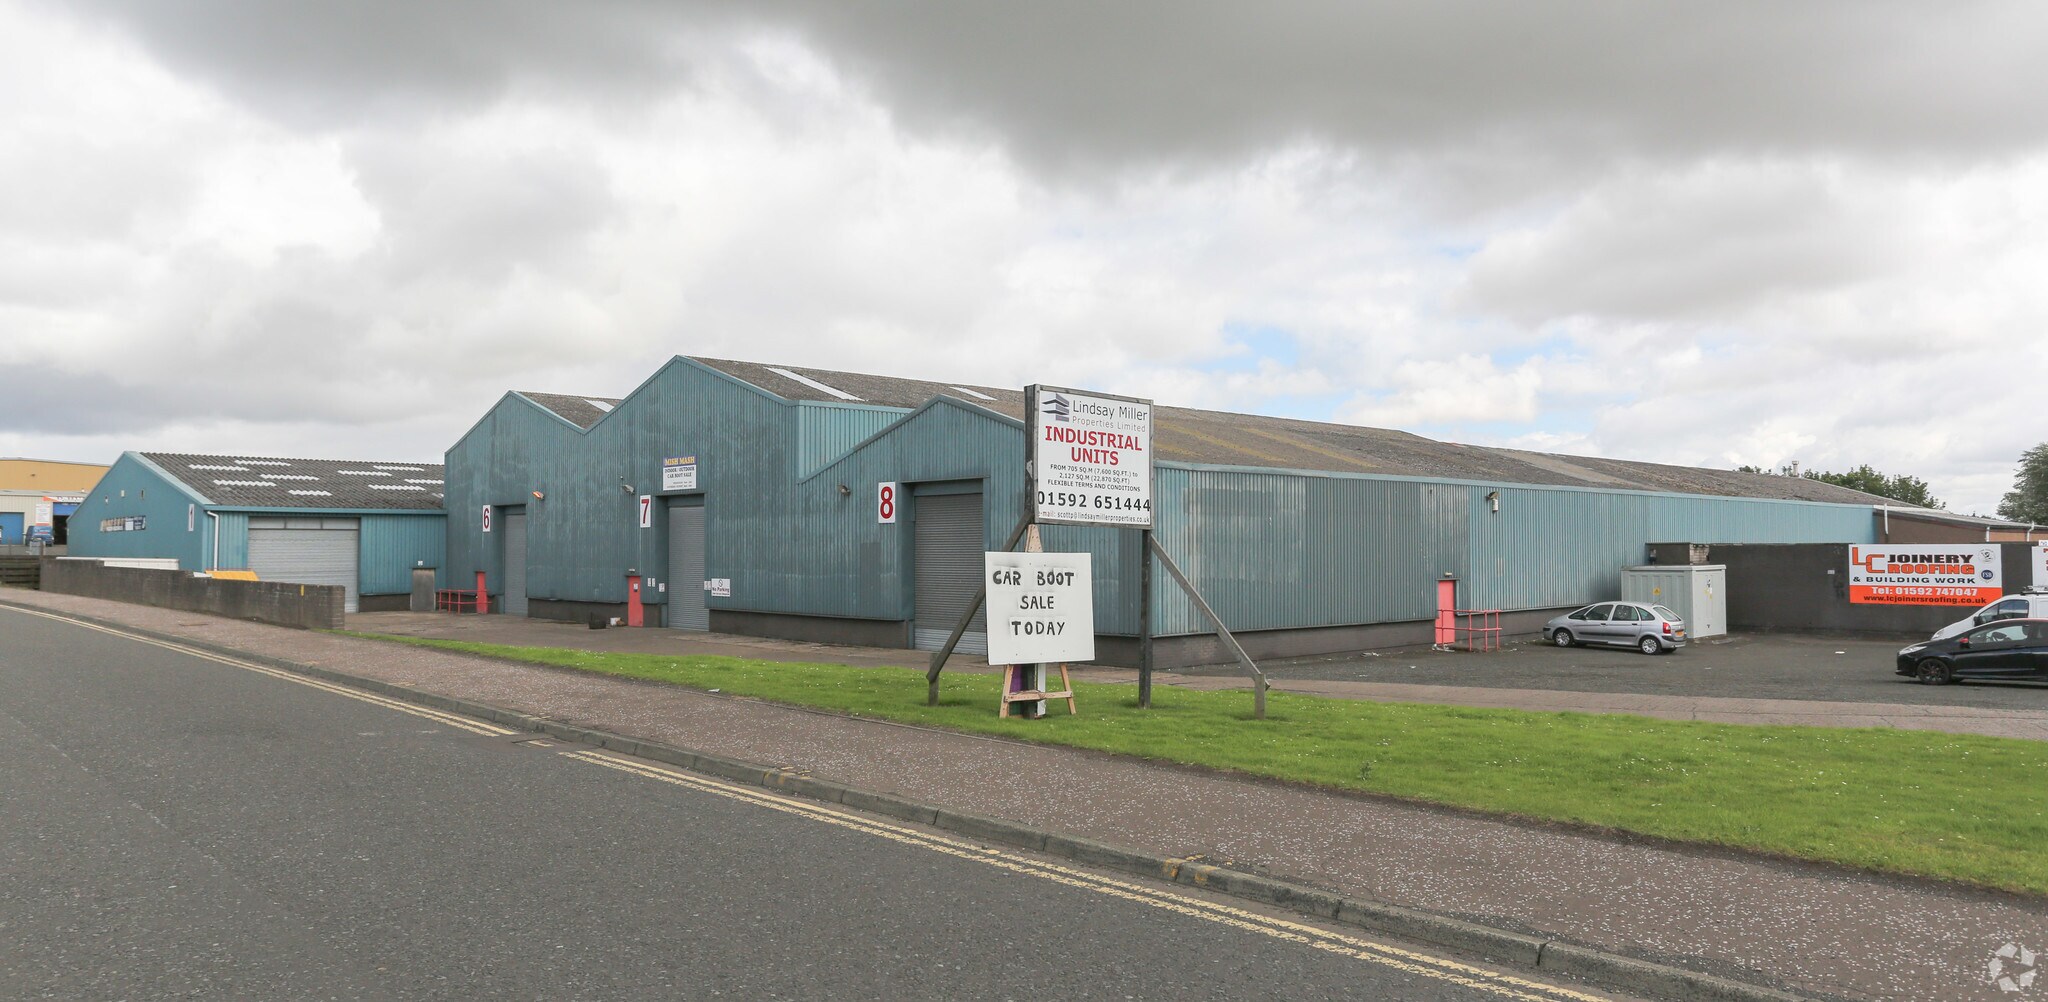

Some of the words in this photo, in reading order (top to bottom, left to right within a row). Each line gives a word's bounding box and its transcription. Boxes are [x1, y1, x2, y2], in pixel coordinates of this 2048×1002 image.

[1073, 400, 1115, 419] Lindsay
[1119, 406, 1148, 420] Miller
[1072, 416, 1114, 429] Properties
[1117, 421, 1146, 432] Limited
[1045, 425, 1142, 451] INDUSTRIAL
[1071, 447, 1119, 466] UNITS
[1047, 479, 1073, 487] FLEXIBLE
[1107, 484, 1141, 492] CONDITIONS
[880, 486, 893, 519] 8
[1038, 490, 1087, 508] 01592
[1094, 495, 1150, 512] 651444
[484, 507, 490, 529] 6
[641, 498, 649, 524] 7
[1852, 547, 1885, 573] LC
[1887, 554, 1974, 563] JOINERY
[1887, 564, 1975, 574] ROOFING
[993, 570, 1021, 585] CAR
[1037, 571, 1074, 586] BOOT
[1863, 595, 1987, 604] www.lcjoinersroofing.co.uk
[1871, 586, 1893, 594] Tel:
[1895, 587, 1933, 595] 01592
[1935, 588, 1978, 596] 747047
[1020, 596, 1054, 610] SALE
[1011, 621, 1065, 635] TODAY
